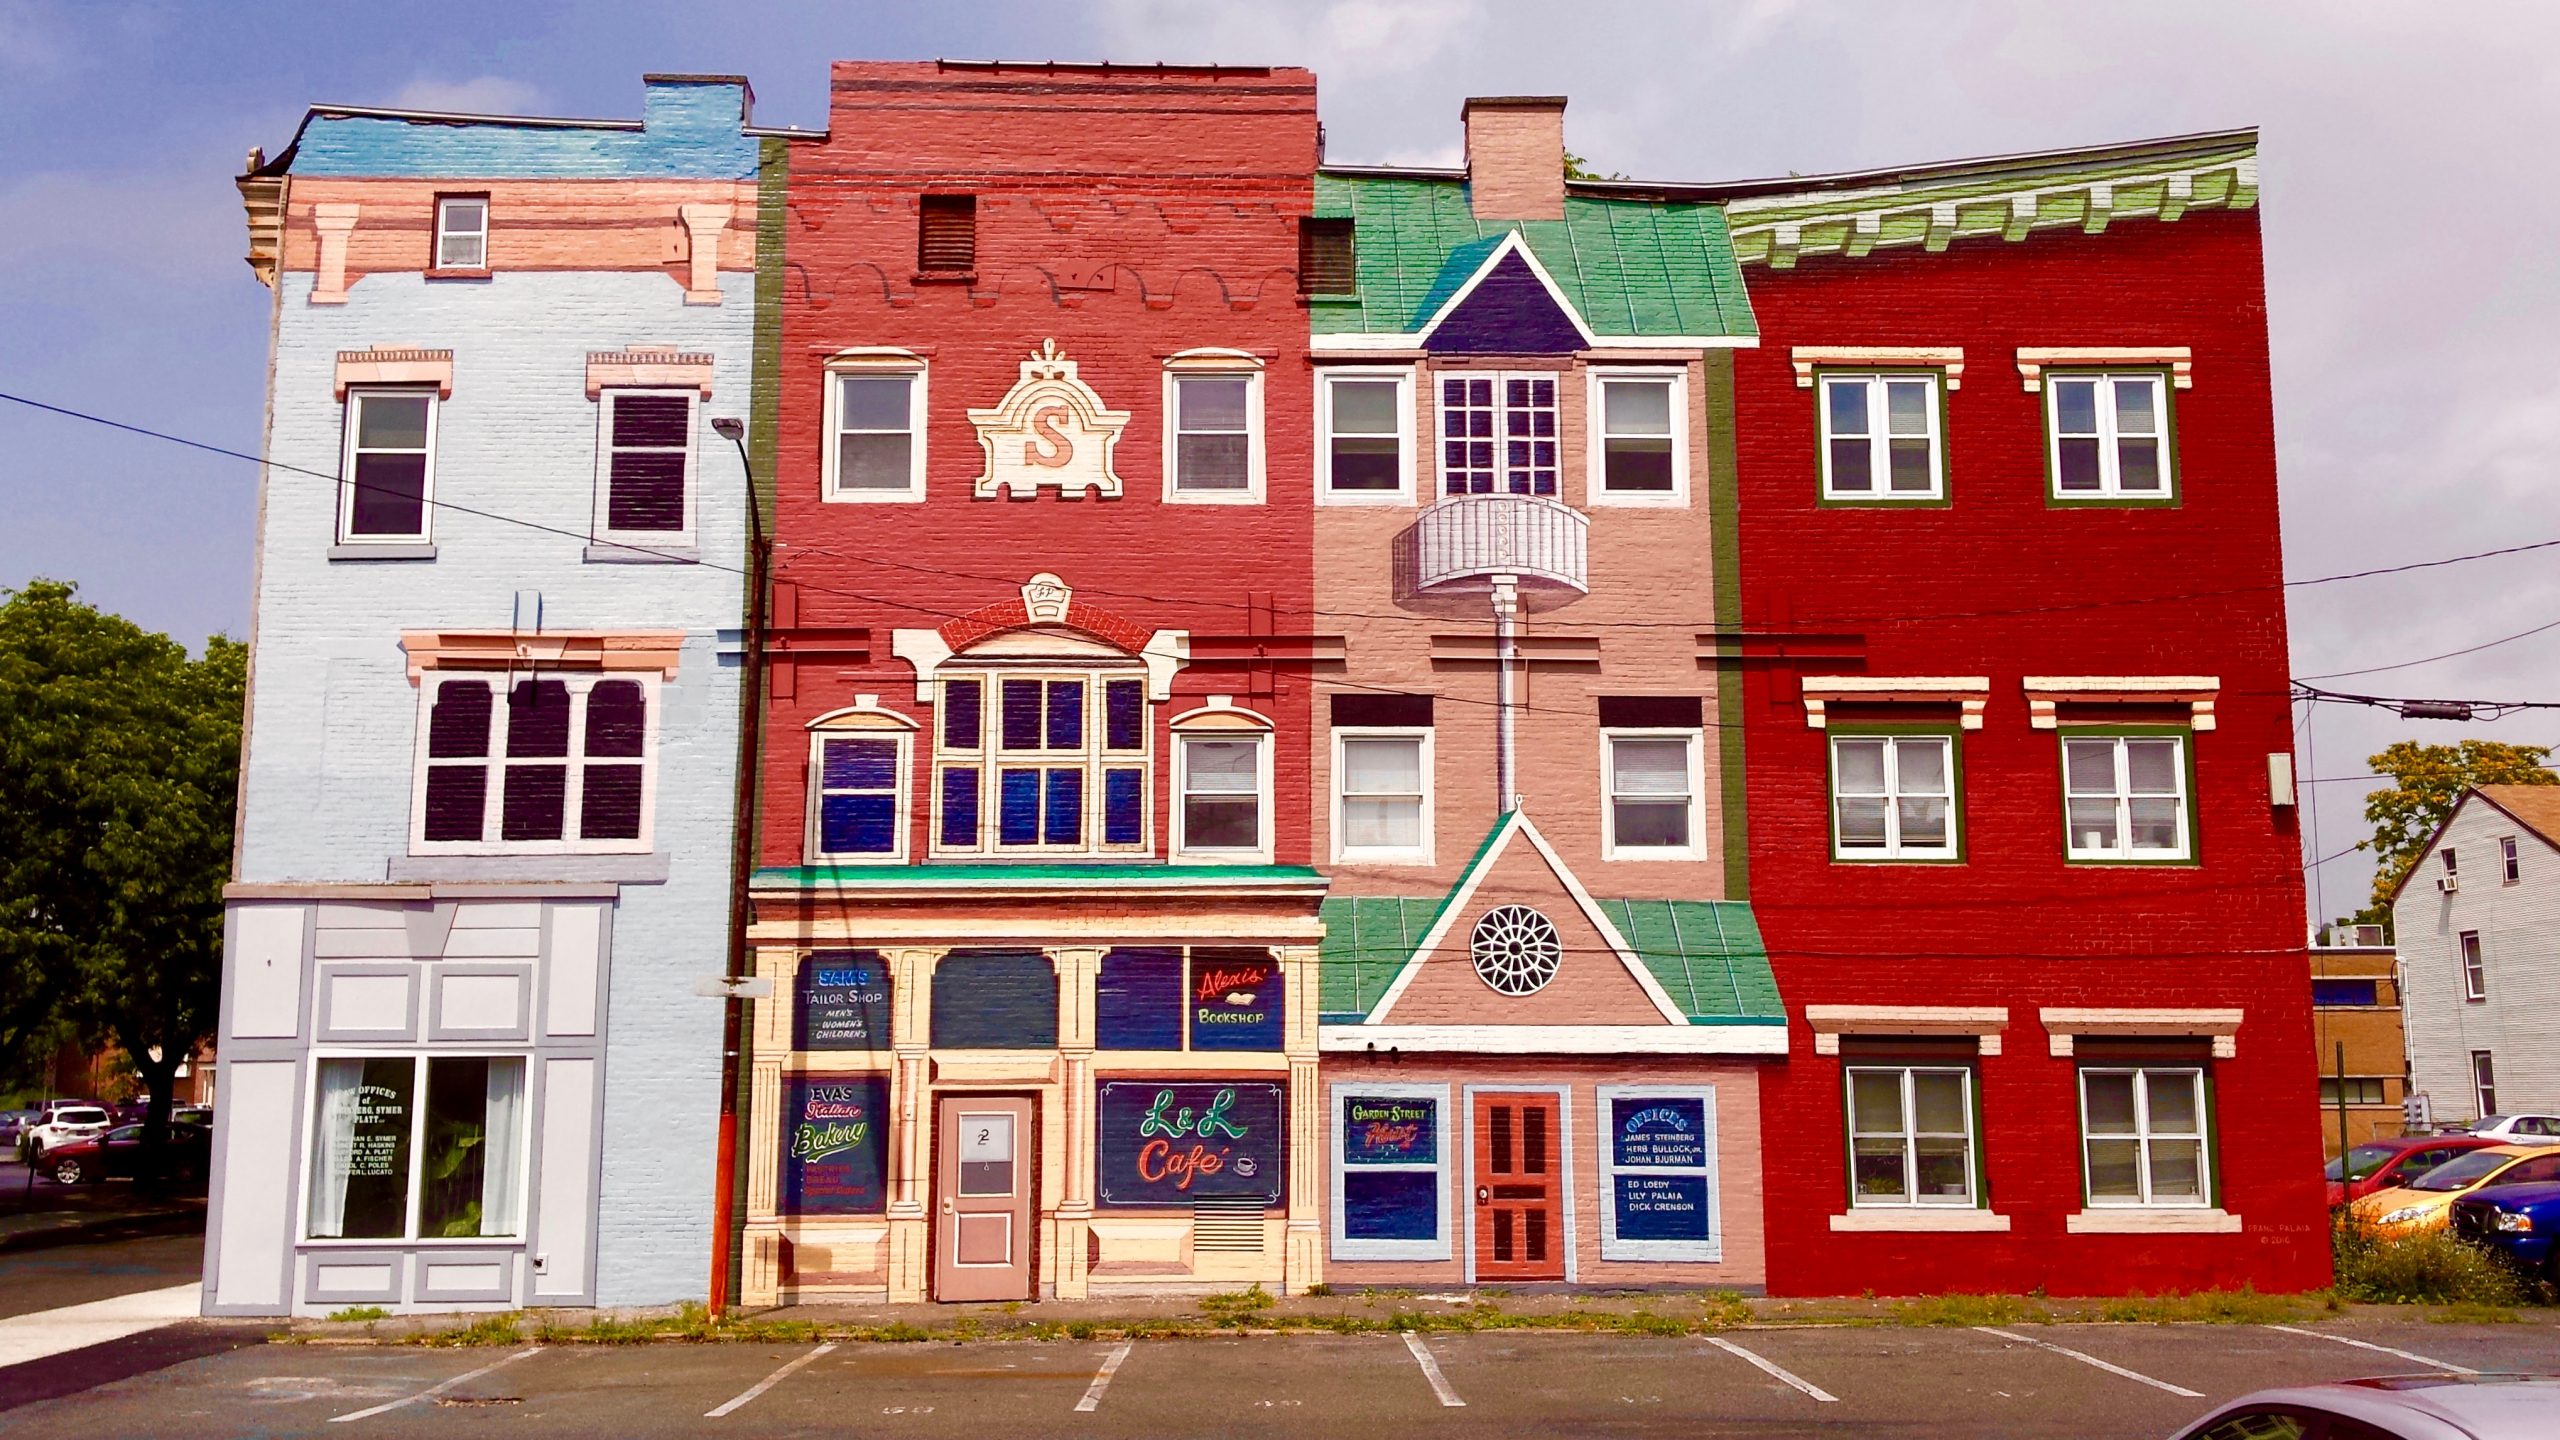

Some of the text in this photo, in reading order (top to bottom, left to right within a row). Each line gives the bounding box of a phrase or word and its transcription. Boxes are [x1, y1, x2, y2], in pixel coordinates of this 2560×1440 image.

[1024, 404, 1074, 468] S
[825, 1008, 853, 1018] MEN'S
[822, 1020, 863, 1029] WOMEN'S
[816, 1030, 868, 1040] CHILDREN'S
[358, 1086, 397, 1099] OFFICES
[811, 1086, 852, 1102] EVA'S
[1625, 1108, 1689, 1133] OFFICES
[791, 1122, 868, 1163] Bakery
[1625, 1134, 1695, 1142] JAMES STEINBERG
[1626, 1145, 1648, 1153] HERB
[1625, 1156, 1652, 1164] JOHAN
[1628, 1181, 1640, 1189] ED
[1628, 1192, 1683, 1200] LILY PALAIA
[1629, 1203, 1694, 1211] DICK CRENSON
